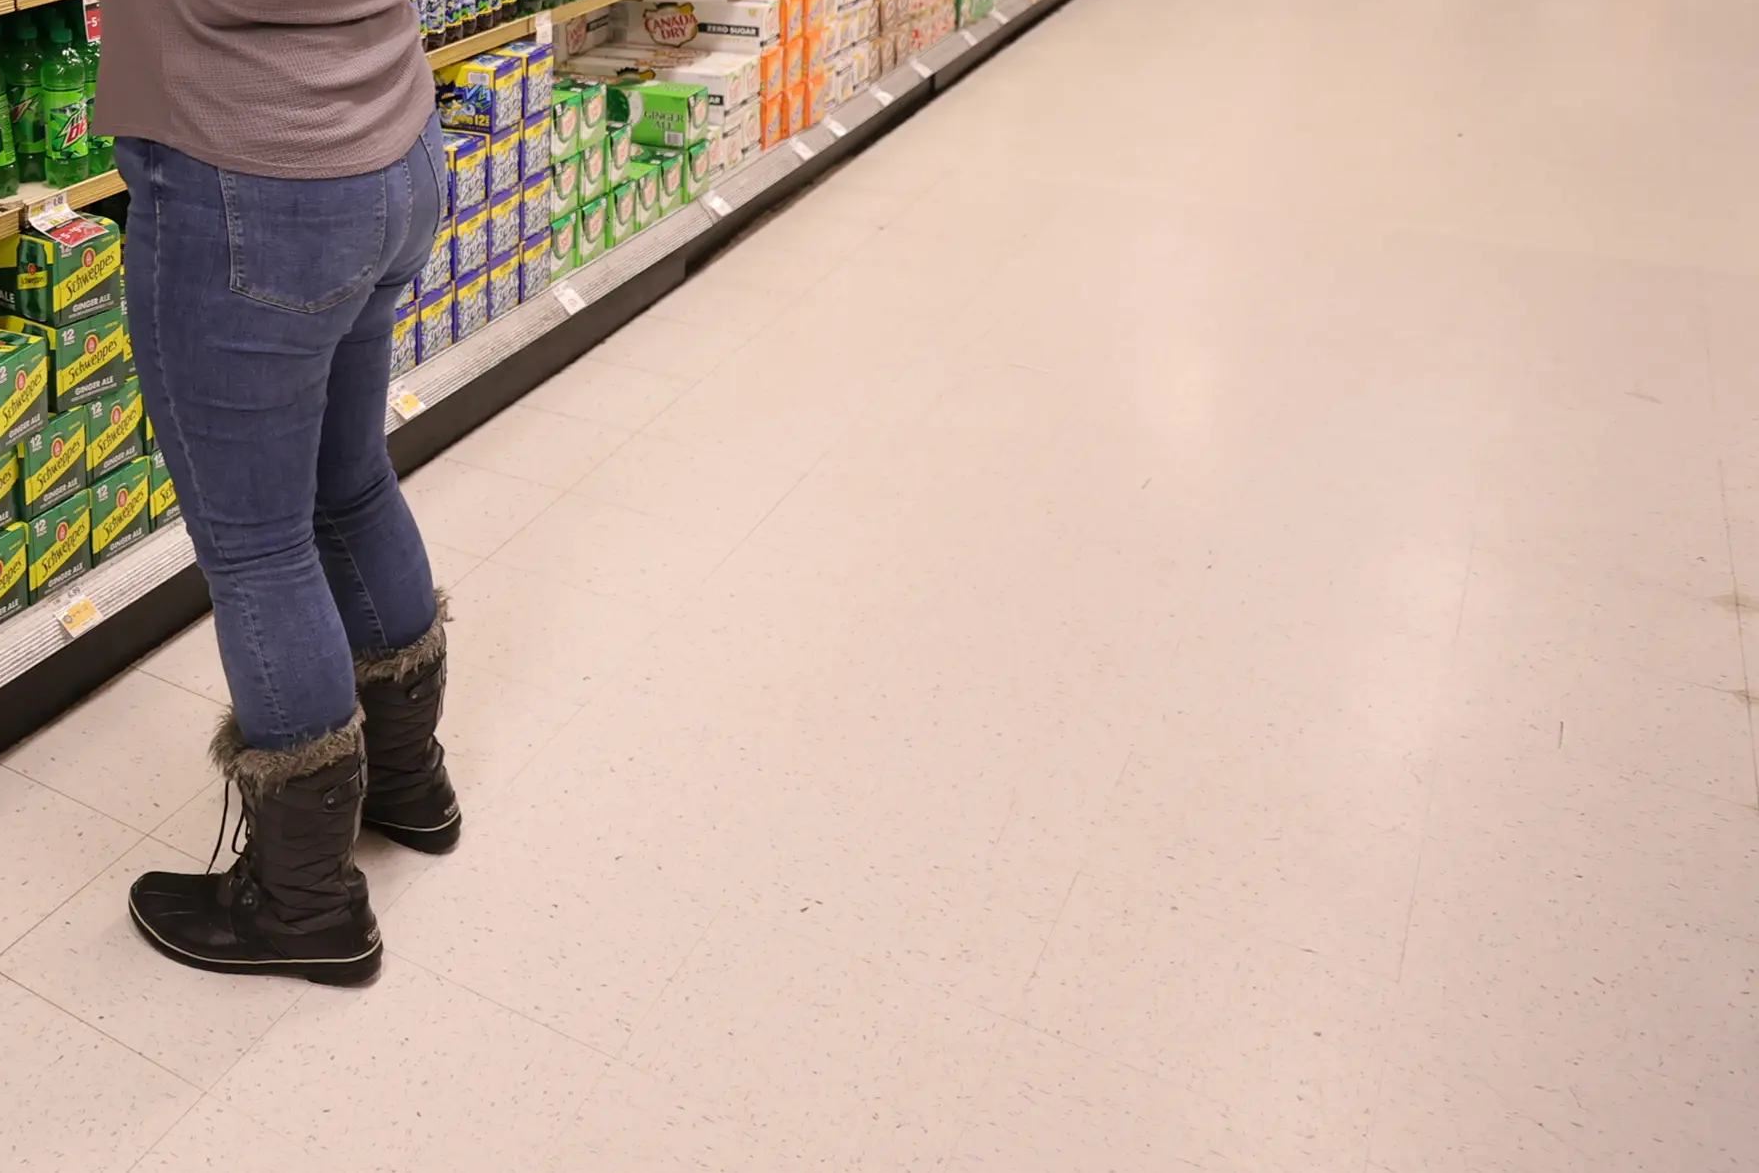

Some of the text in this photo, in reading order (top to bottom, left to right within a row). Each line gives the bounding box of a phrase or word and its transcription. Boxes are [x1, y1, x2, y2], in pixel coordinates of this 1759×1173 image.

[645, 13, 697, 33] CANADA
[707, 25, 757, 35] ZERO SUGAR
[662, 27, 688, 40] DRY
[643, 110, 685, 125] GINGER
[66, 252, 116, 300] Schweppes
[73, 296, 98, 312] GINGER
